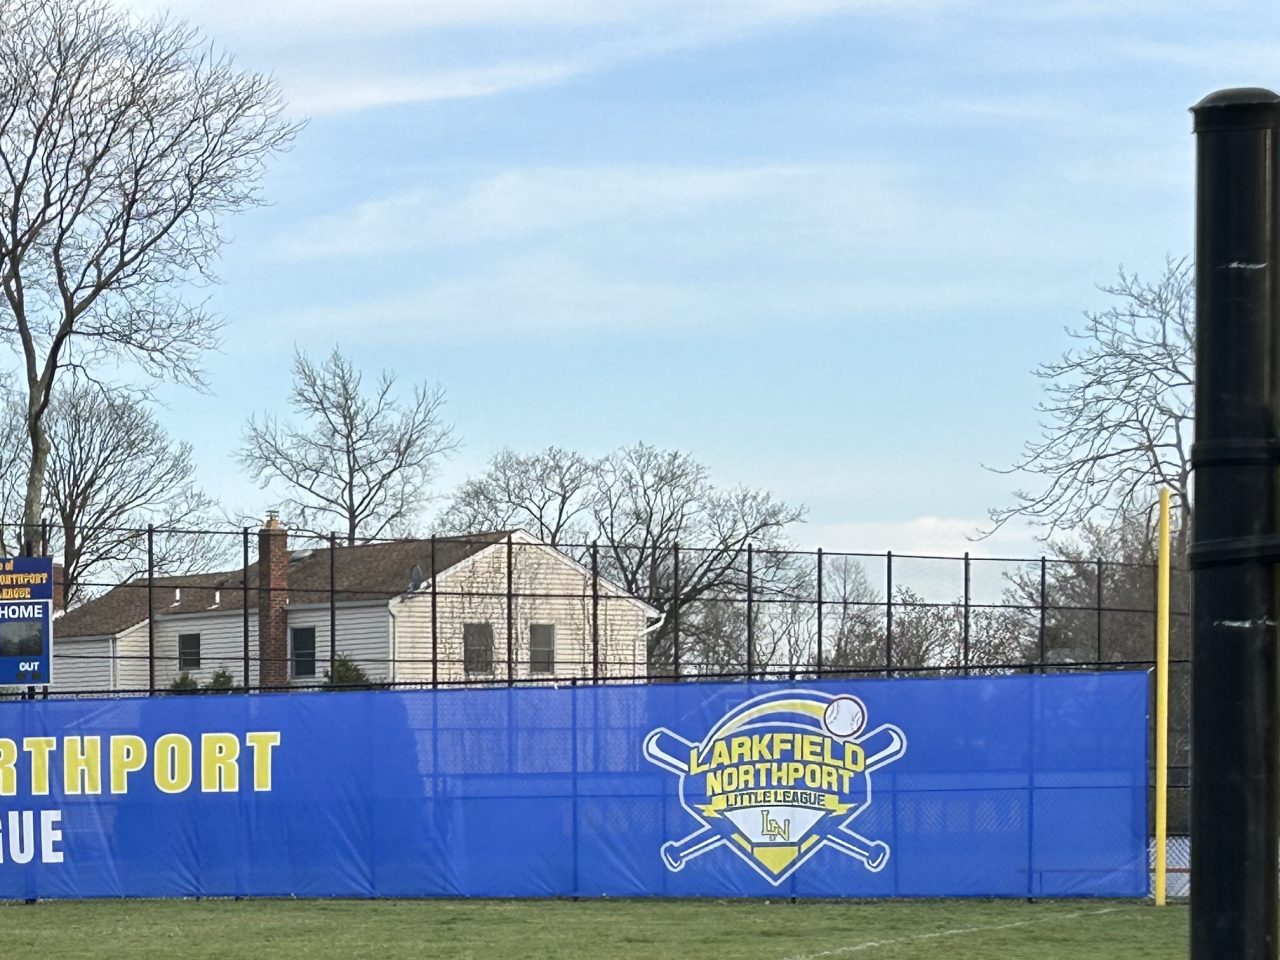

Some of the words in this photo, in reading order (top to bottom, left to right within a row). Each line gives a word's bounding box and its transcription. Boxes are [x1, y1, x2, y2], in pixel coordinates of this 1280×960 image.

[4, 560, 14, 571] of
[19, 662, 40, 671] OUT
[689, 733, 865, 776] LARKFIELD
[706, 763, 855, 797] NORTHPORT
[726, 792, 771, 807] LITTLE
[774, 790, 826, 807] LEAGUE
